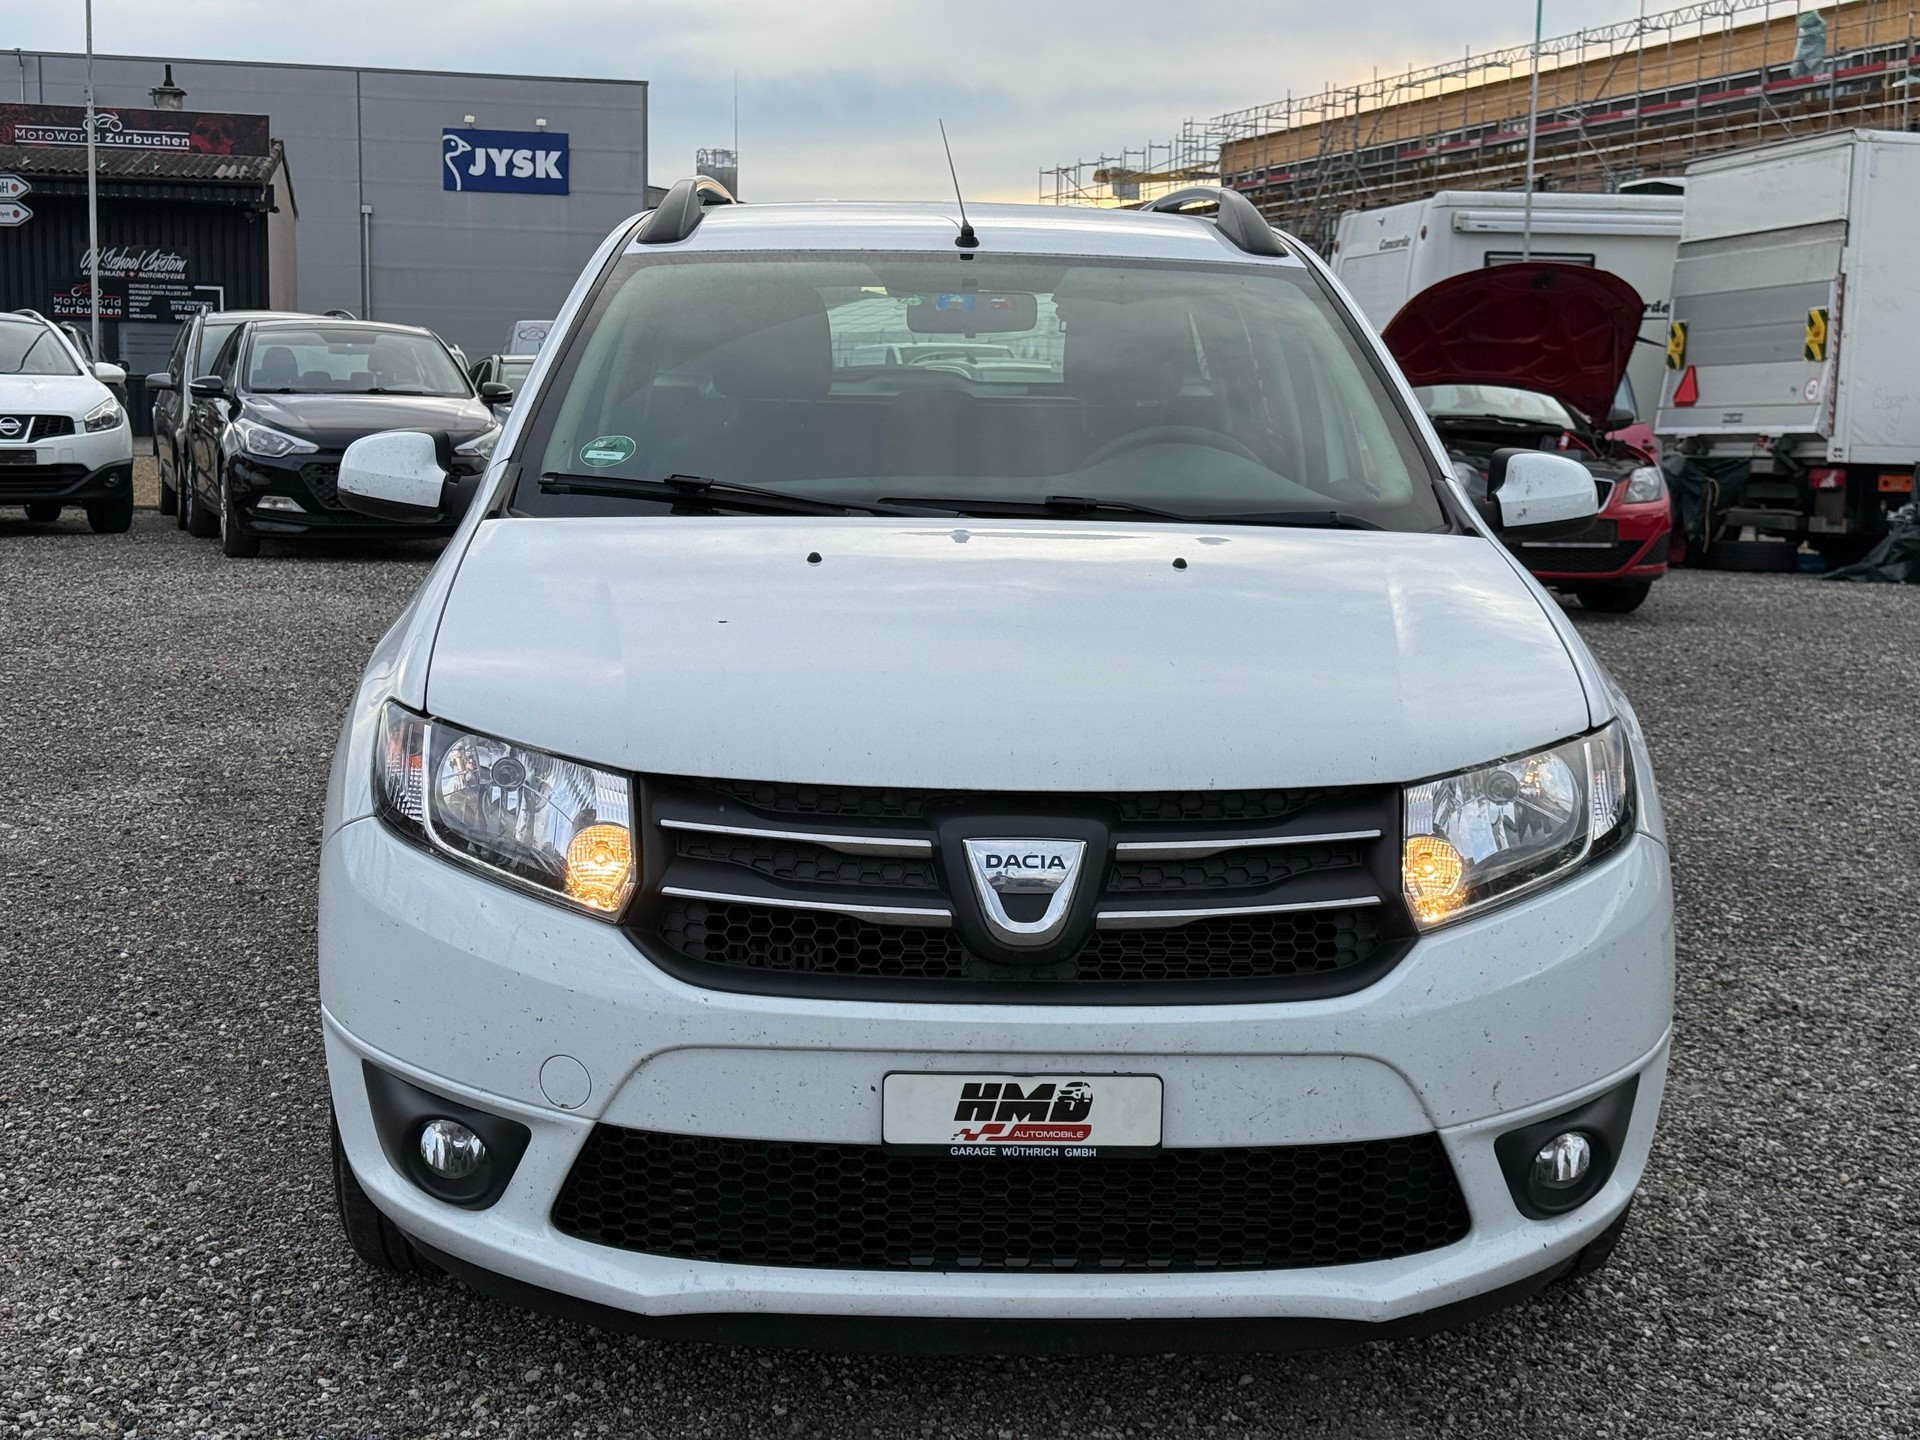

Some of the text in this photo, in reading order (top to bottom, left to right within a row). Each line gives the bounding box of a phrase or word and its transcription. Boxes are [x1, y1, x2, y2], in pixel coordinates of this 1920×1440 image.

[15, 128, 190, 147] MotoWord Zurbuchen
[468, 147, 563, 179] JYSK
[102, 246, 147, 270] School
[141, 248, 188, 272] Custom
[54, 305, 122, 315] Zurbuhen
[985, 854, 1066, 870] DACIA
[1013, 1130, 1085, 1139] AUTOMOBILE
[950, 1145, 1097, 1158] GARAGE WÜTHRICH GMBH
